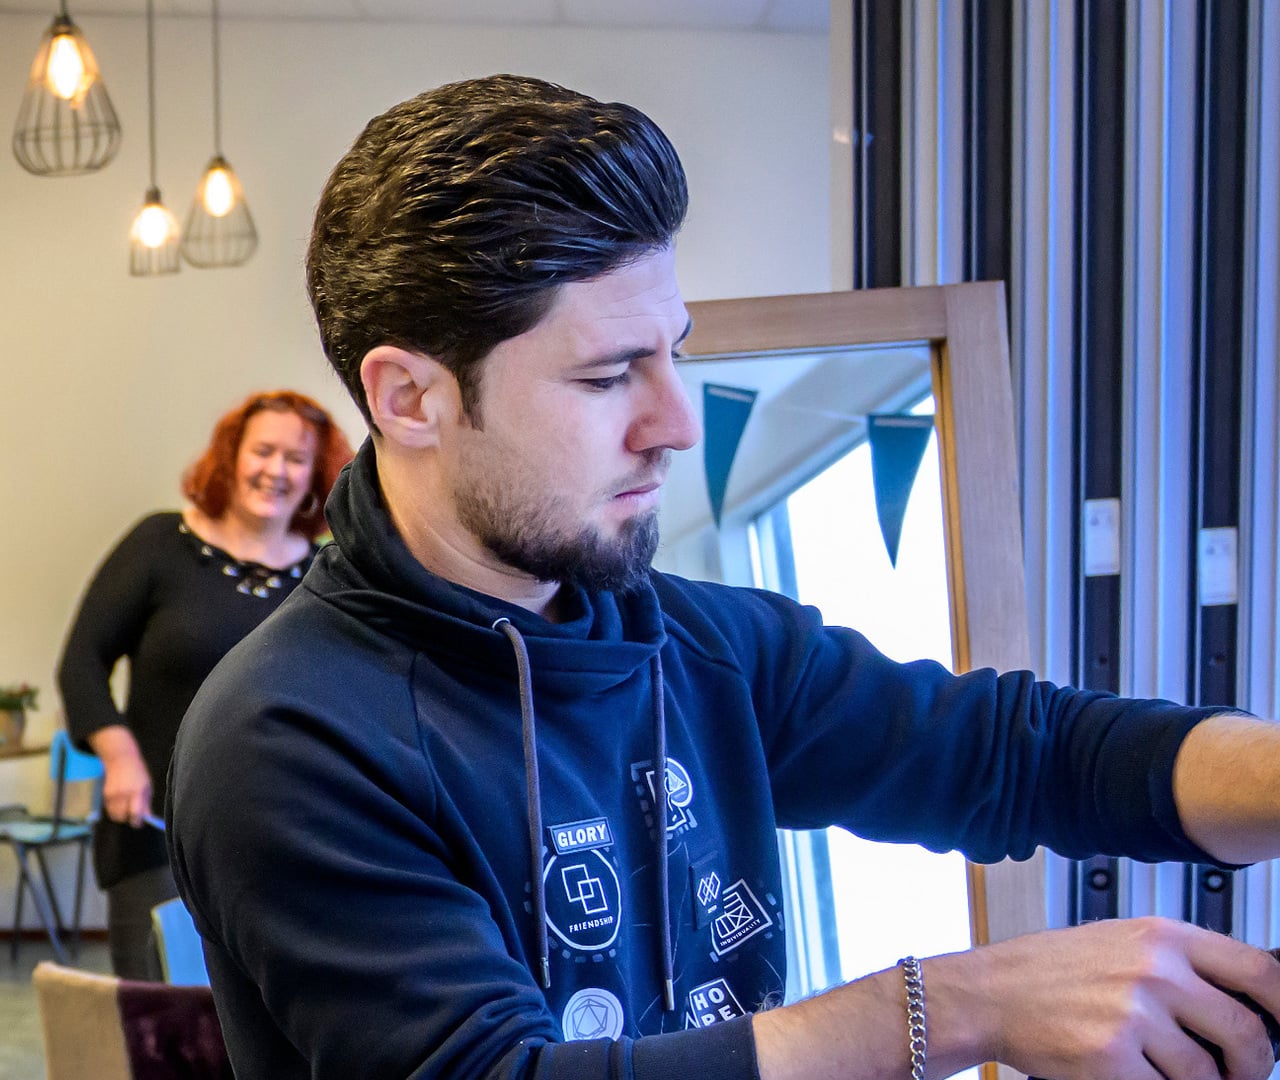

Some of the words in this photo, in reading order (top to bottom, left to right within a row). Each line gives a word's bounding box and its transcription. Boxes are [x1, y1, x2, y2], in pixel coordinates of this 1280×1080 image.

[557, 823, 606, 848] GLORY
[569, 915, 613, 933] FRIENDSHIP
[720, 918, 761, 946] INDIVIDUALITY
